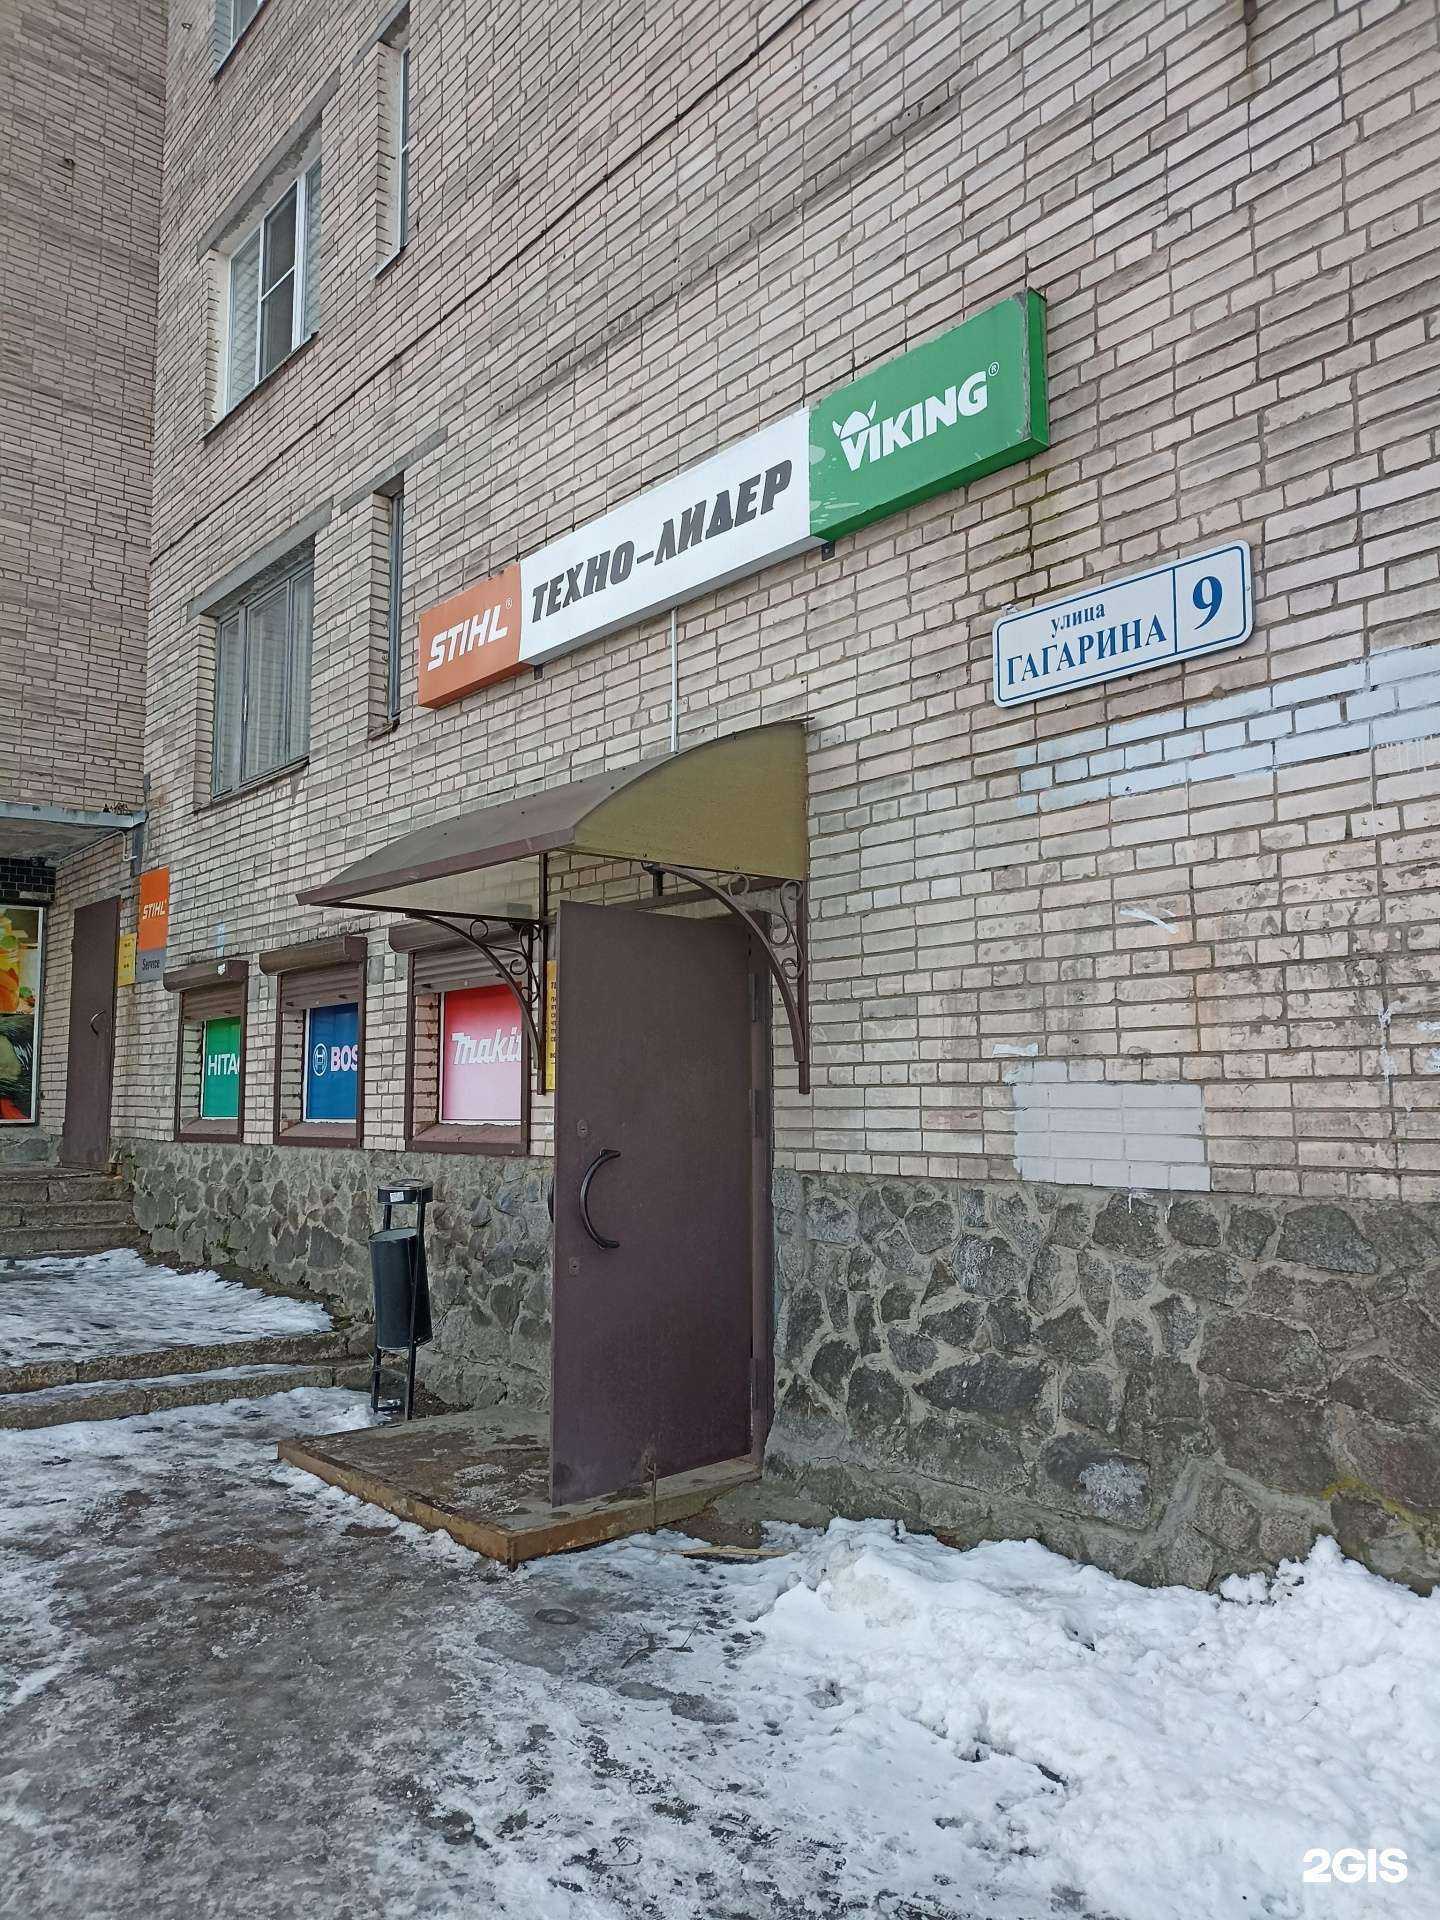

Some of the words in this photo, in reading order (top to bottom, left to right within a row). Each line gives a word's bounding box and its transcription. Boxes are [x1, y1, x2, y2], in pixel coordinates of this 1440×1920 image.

[840, 371, 988, 472] VIKING
[531, 459, 793, 623] ТЕХНО-ЛИДЕР
[1052, 603, 1106, 638] улица
[1192, 575, 1223, 630] 9
[427, 603, 508, 671] STIHL
[1007, 613, 1167, 686] ГАГАРИНА
[142, 901, 166, 920] STIHL
[142, 958, 160, 971] Service
